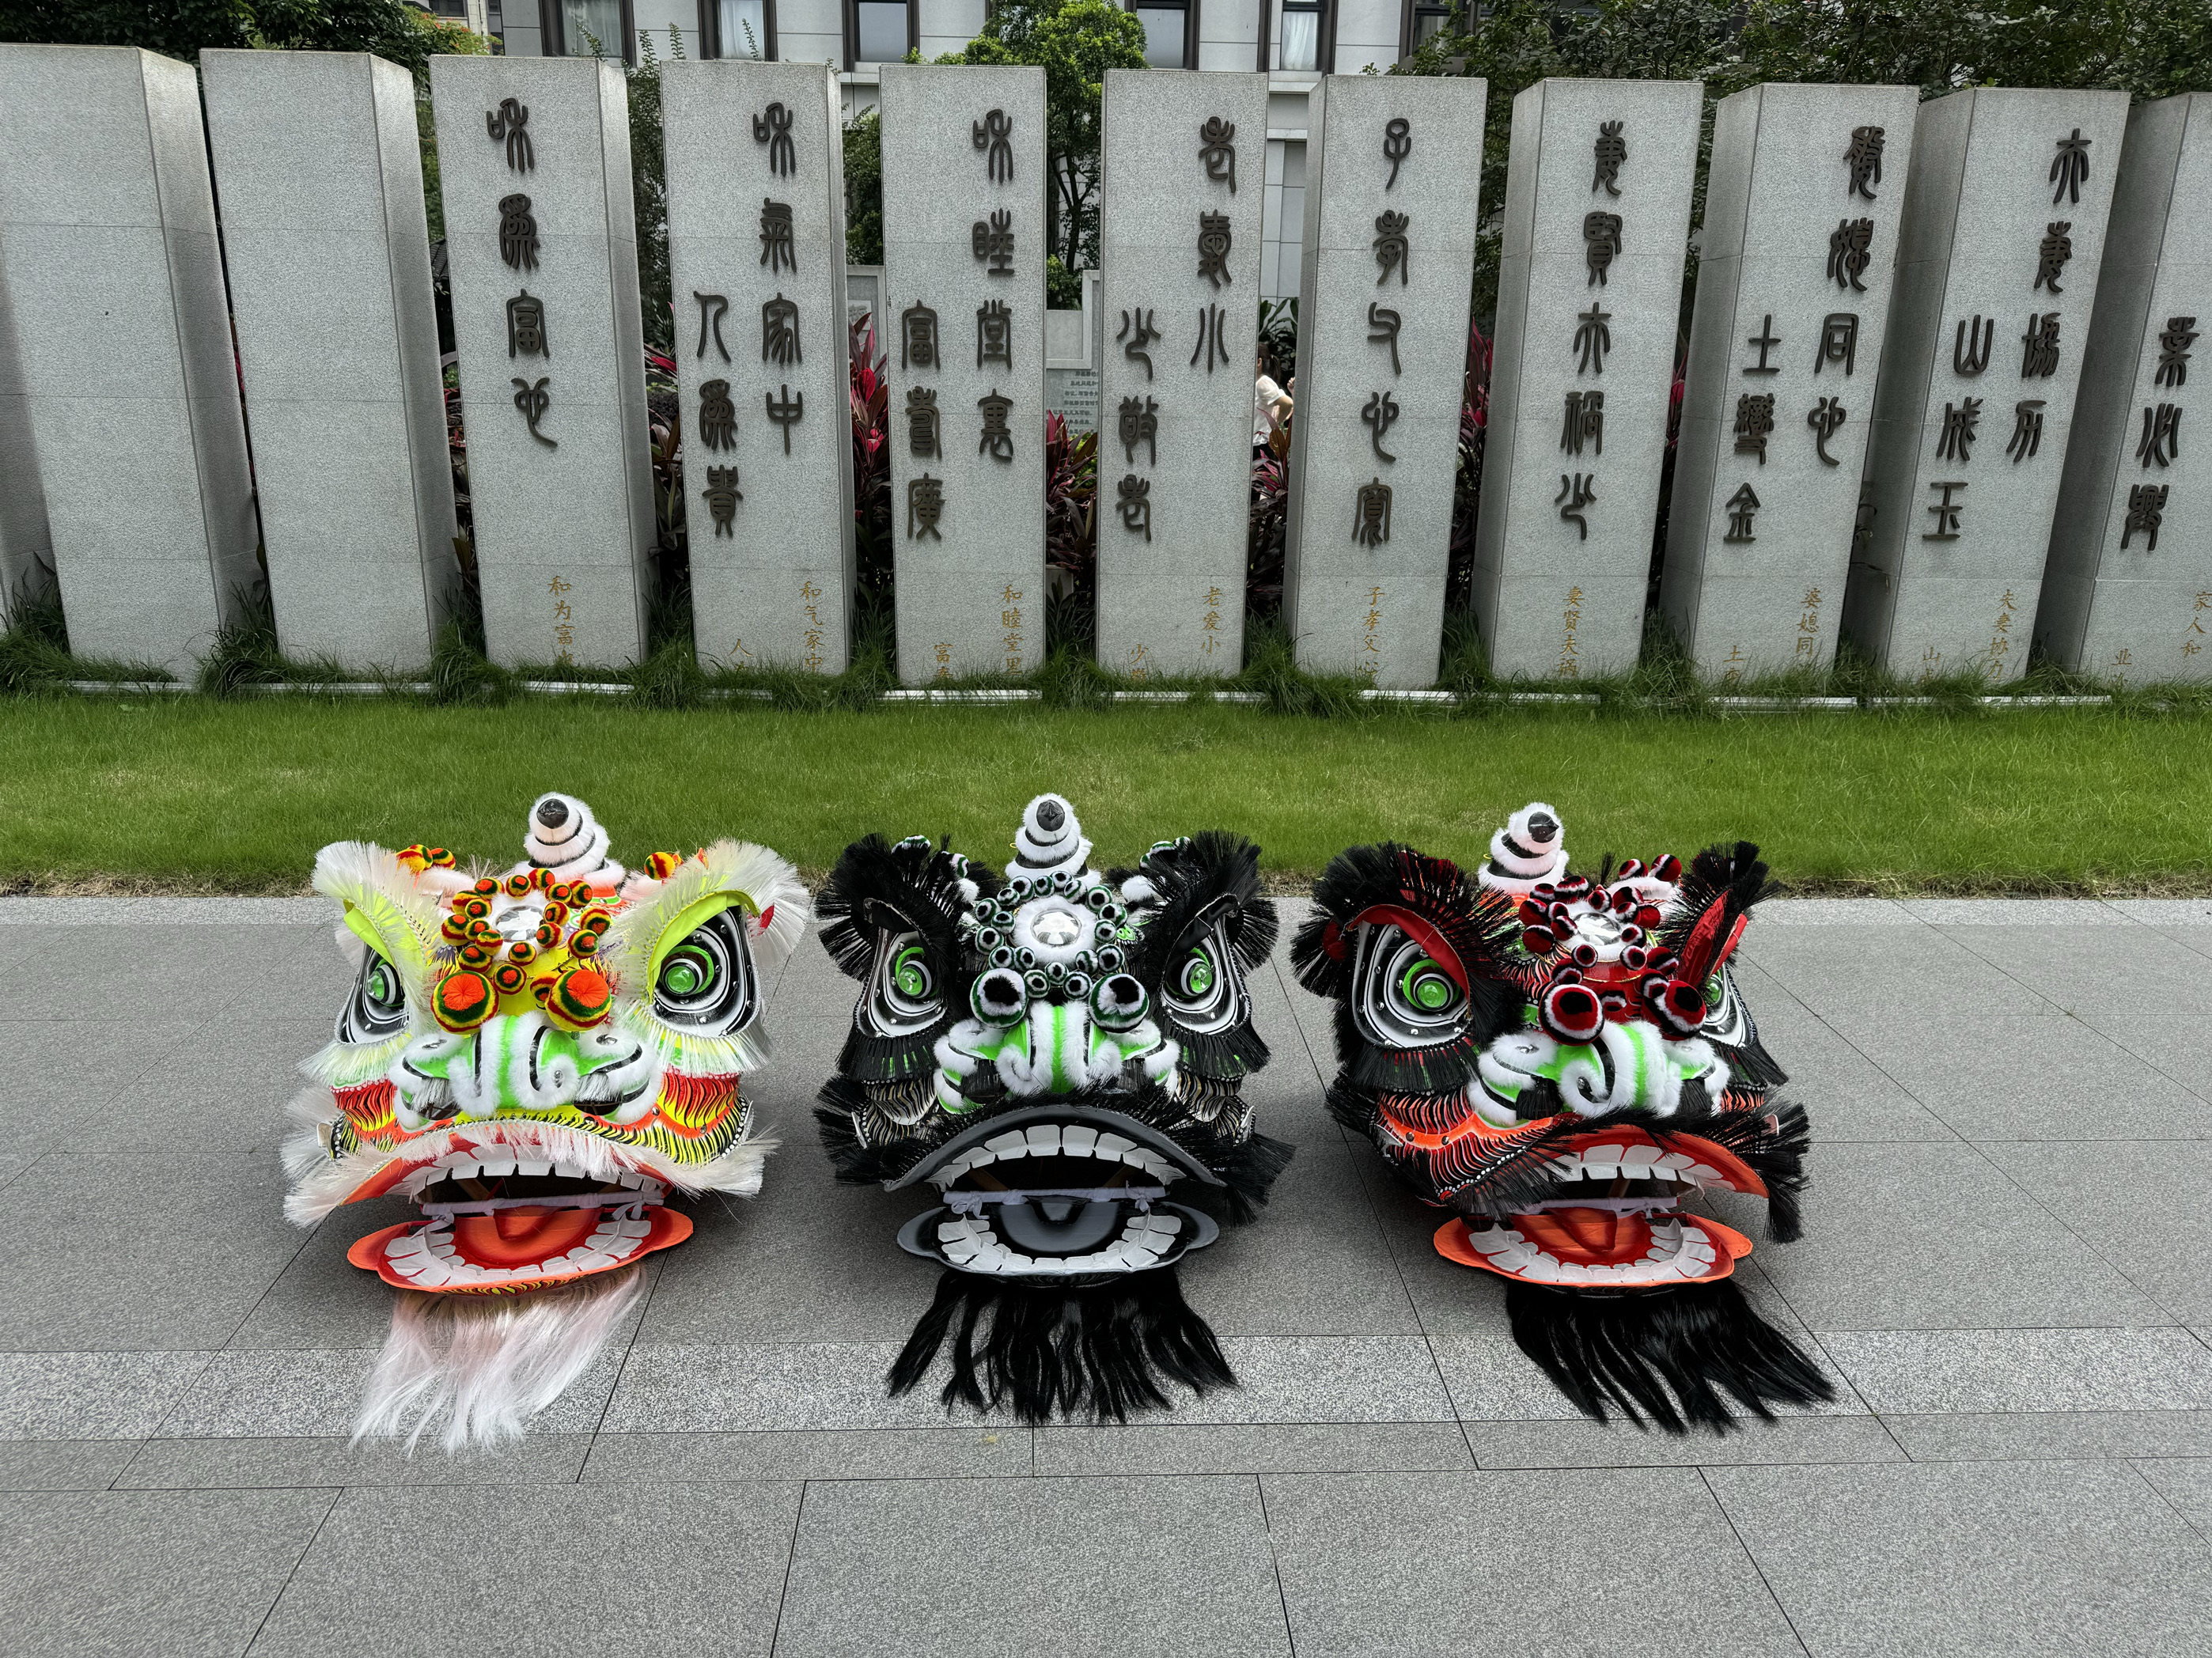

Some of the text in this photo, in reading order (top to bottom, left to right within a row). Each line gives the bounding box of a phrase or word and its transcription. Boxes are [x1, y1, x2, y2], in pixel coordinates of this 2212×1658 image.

[799, 581, 825, 673] 和气家中
[1001, 584, 1023, 676] 和睦堂里
[1202, 587, 1223, 655] 老爱小
[1557, 586, 1585, 677] 妻贤夫祸
[1987, 589, 2017, 681] 夫妻协力
[2180, 592, 2212, 657] 家人和
